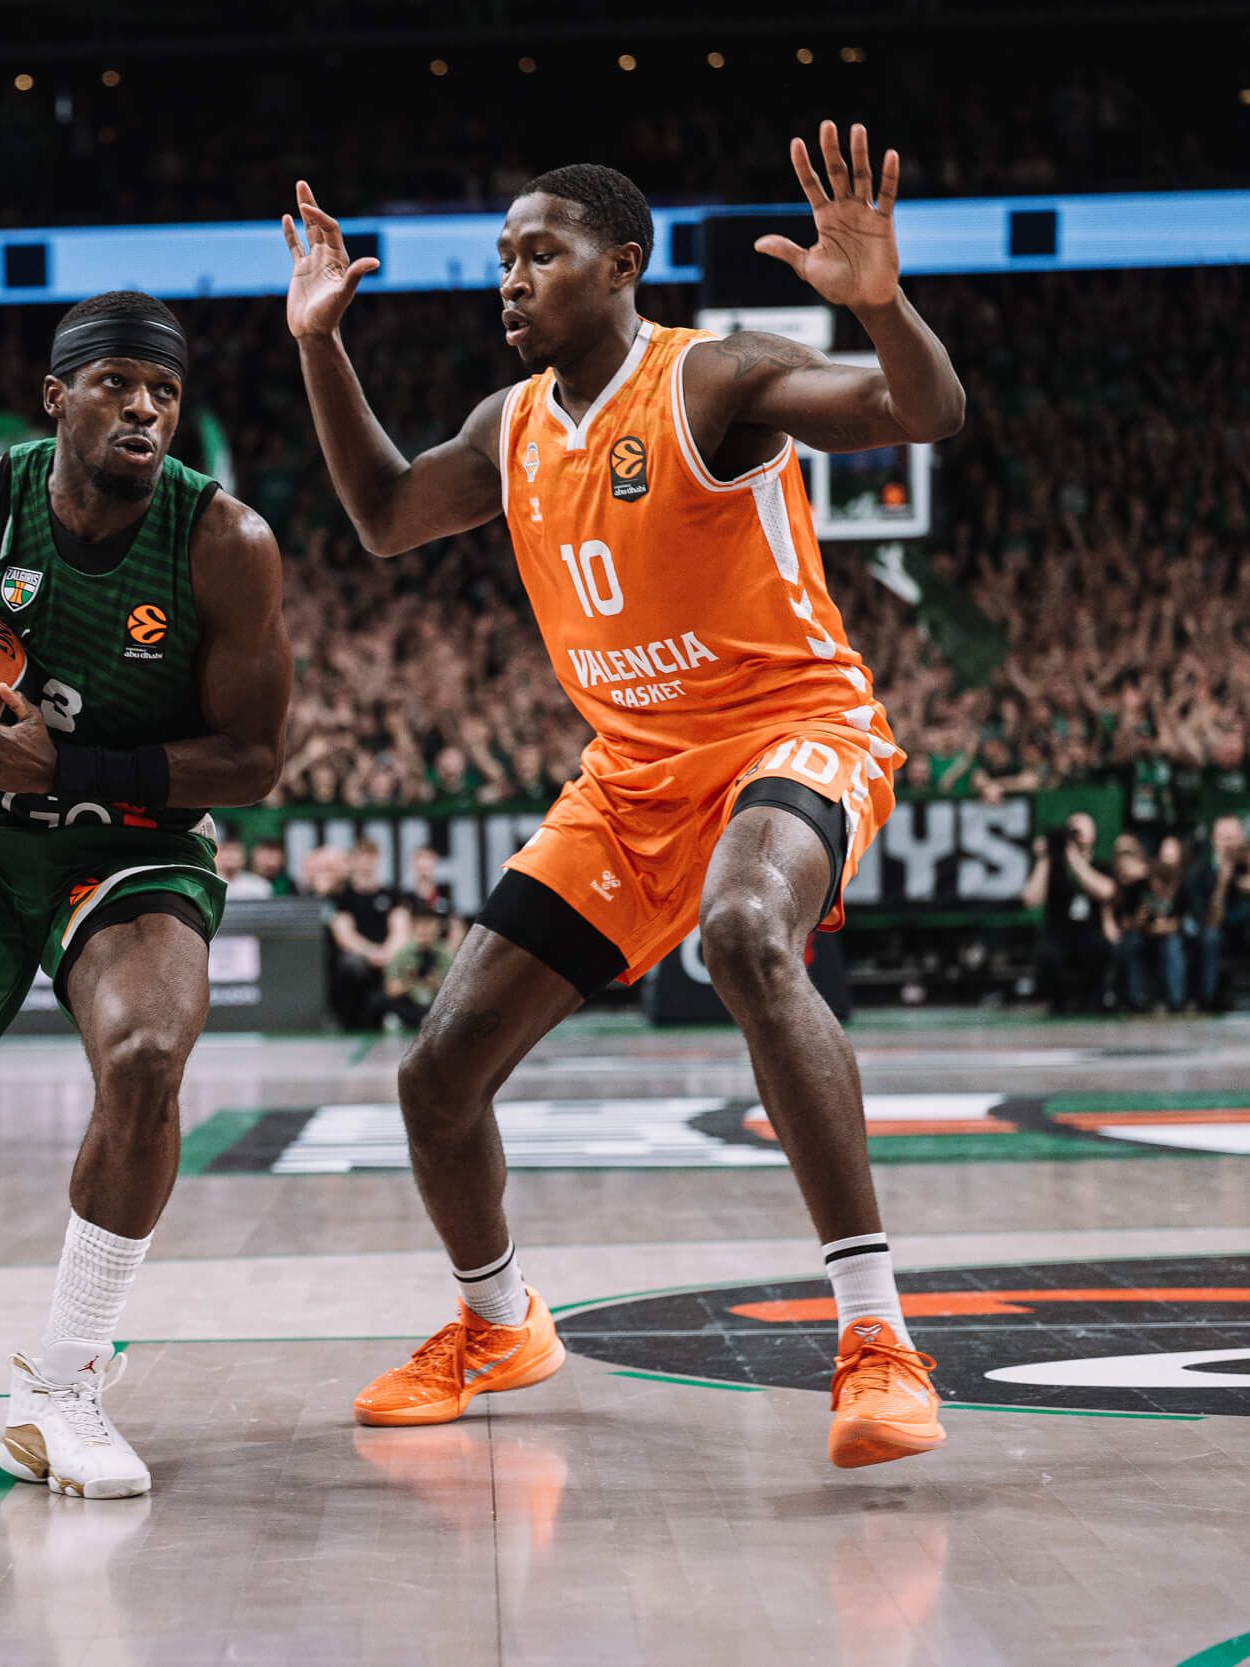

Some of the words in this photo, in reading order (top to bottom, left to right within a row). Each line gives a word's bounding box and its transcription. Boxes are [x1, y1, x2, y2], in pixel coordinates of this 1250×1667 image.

[560, 539, 624, 618] 10
[567, 631, 719, 689] VALENCIA
[611, 679, 686, 708] BASKET
[764, 738, 839, 784] 10
